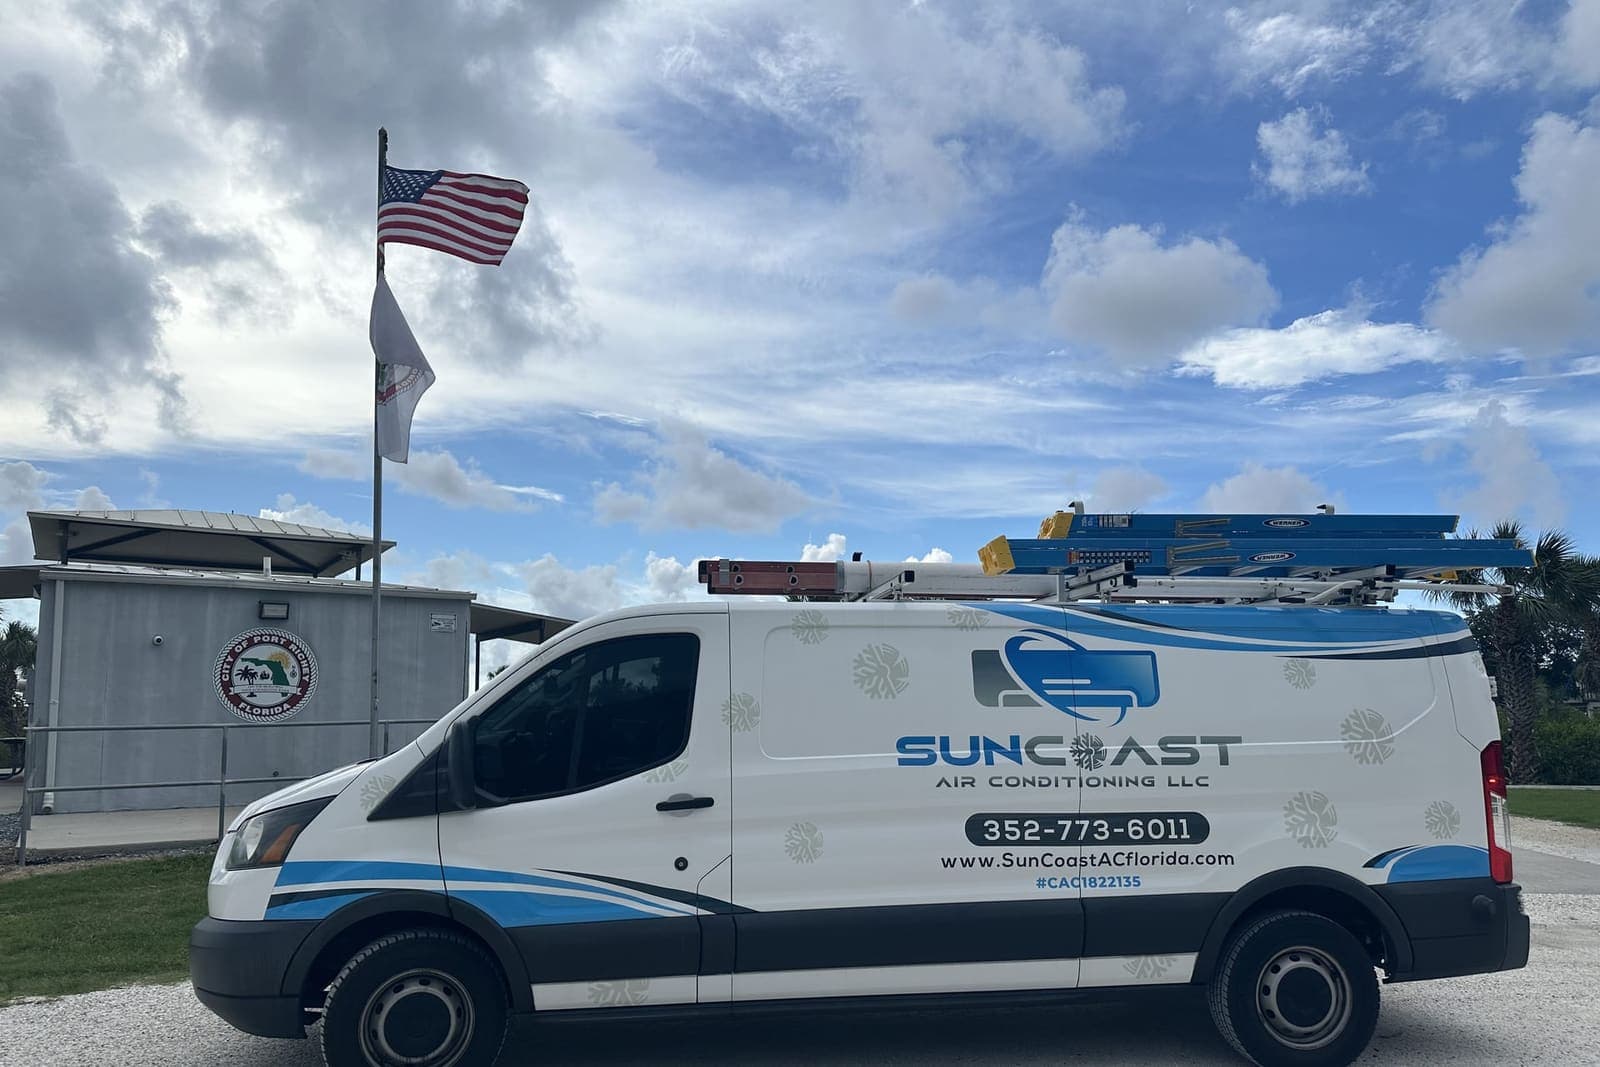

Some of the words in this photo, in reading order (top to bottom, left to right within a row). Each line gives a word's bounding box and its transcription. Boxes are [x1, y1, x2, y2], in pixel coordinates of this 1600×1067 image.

[221, 657, 234, 681] CITY
[234, 640, 249, 653] OF
[253, 635, 287, 645] PORT
[288, 644, 310, 682] RICHEY
[238, 702, 291, 716] FLORIDA
[896, 733, 1242, 771] SUNCOAST
[935, 776, 976, 788] AIR
[988, 775, 1156, 788] CONDITIONING
[1167, 775, 1209, 788] LLC
[983, 818, 1191, 841] 352-773-6011
[941, 851, 1235, 868] www.SunCoastACflorida.com
[1036, 876, 1141, 889] #CAC1822135
